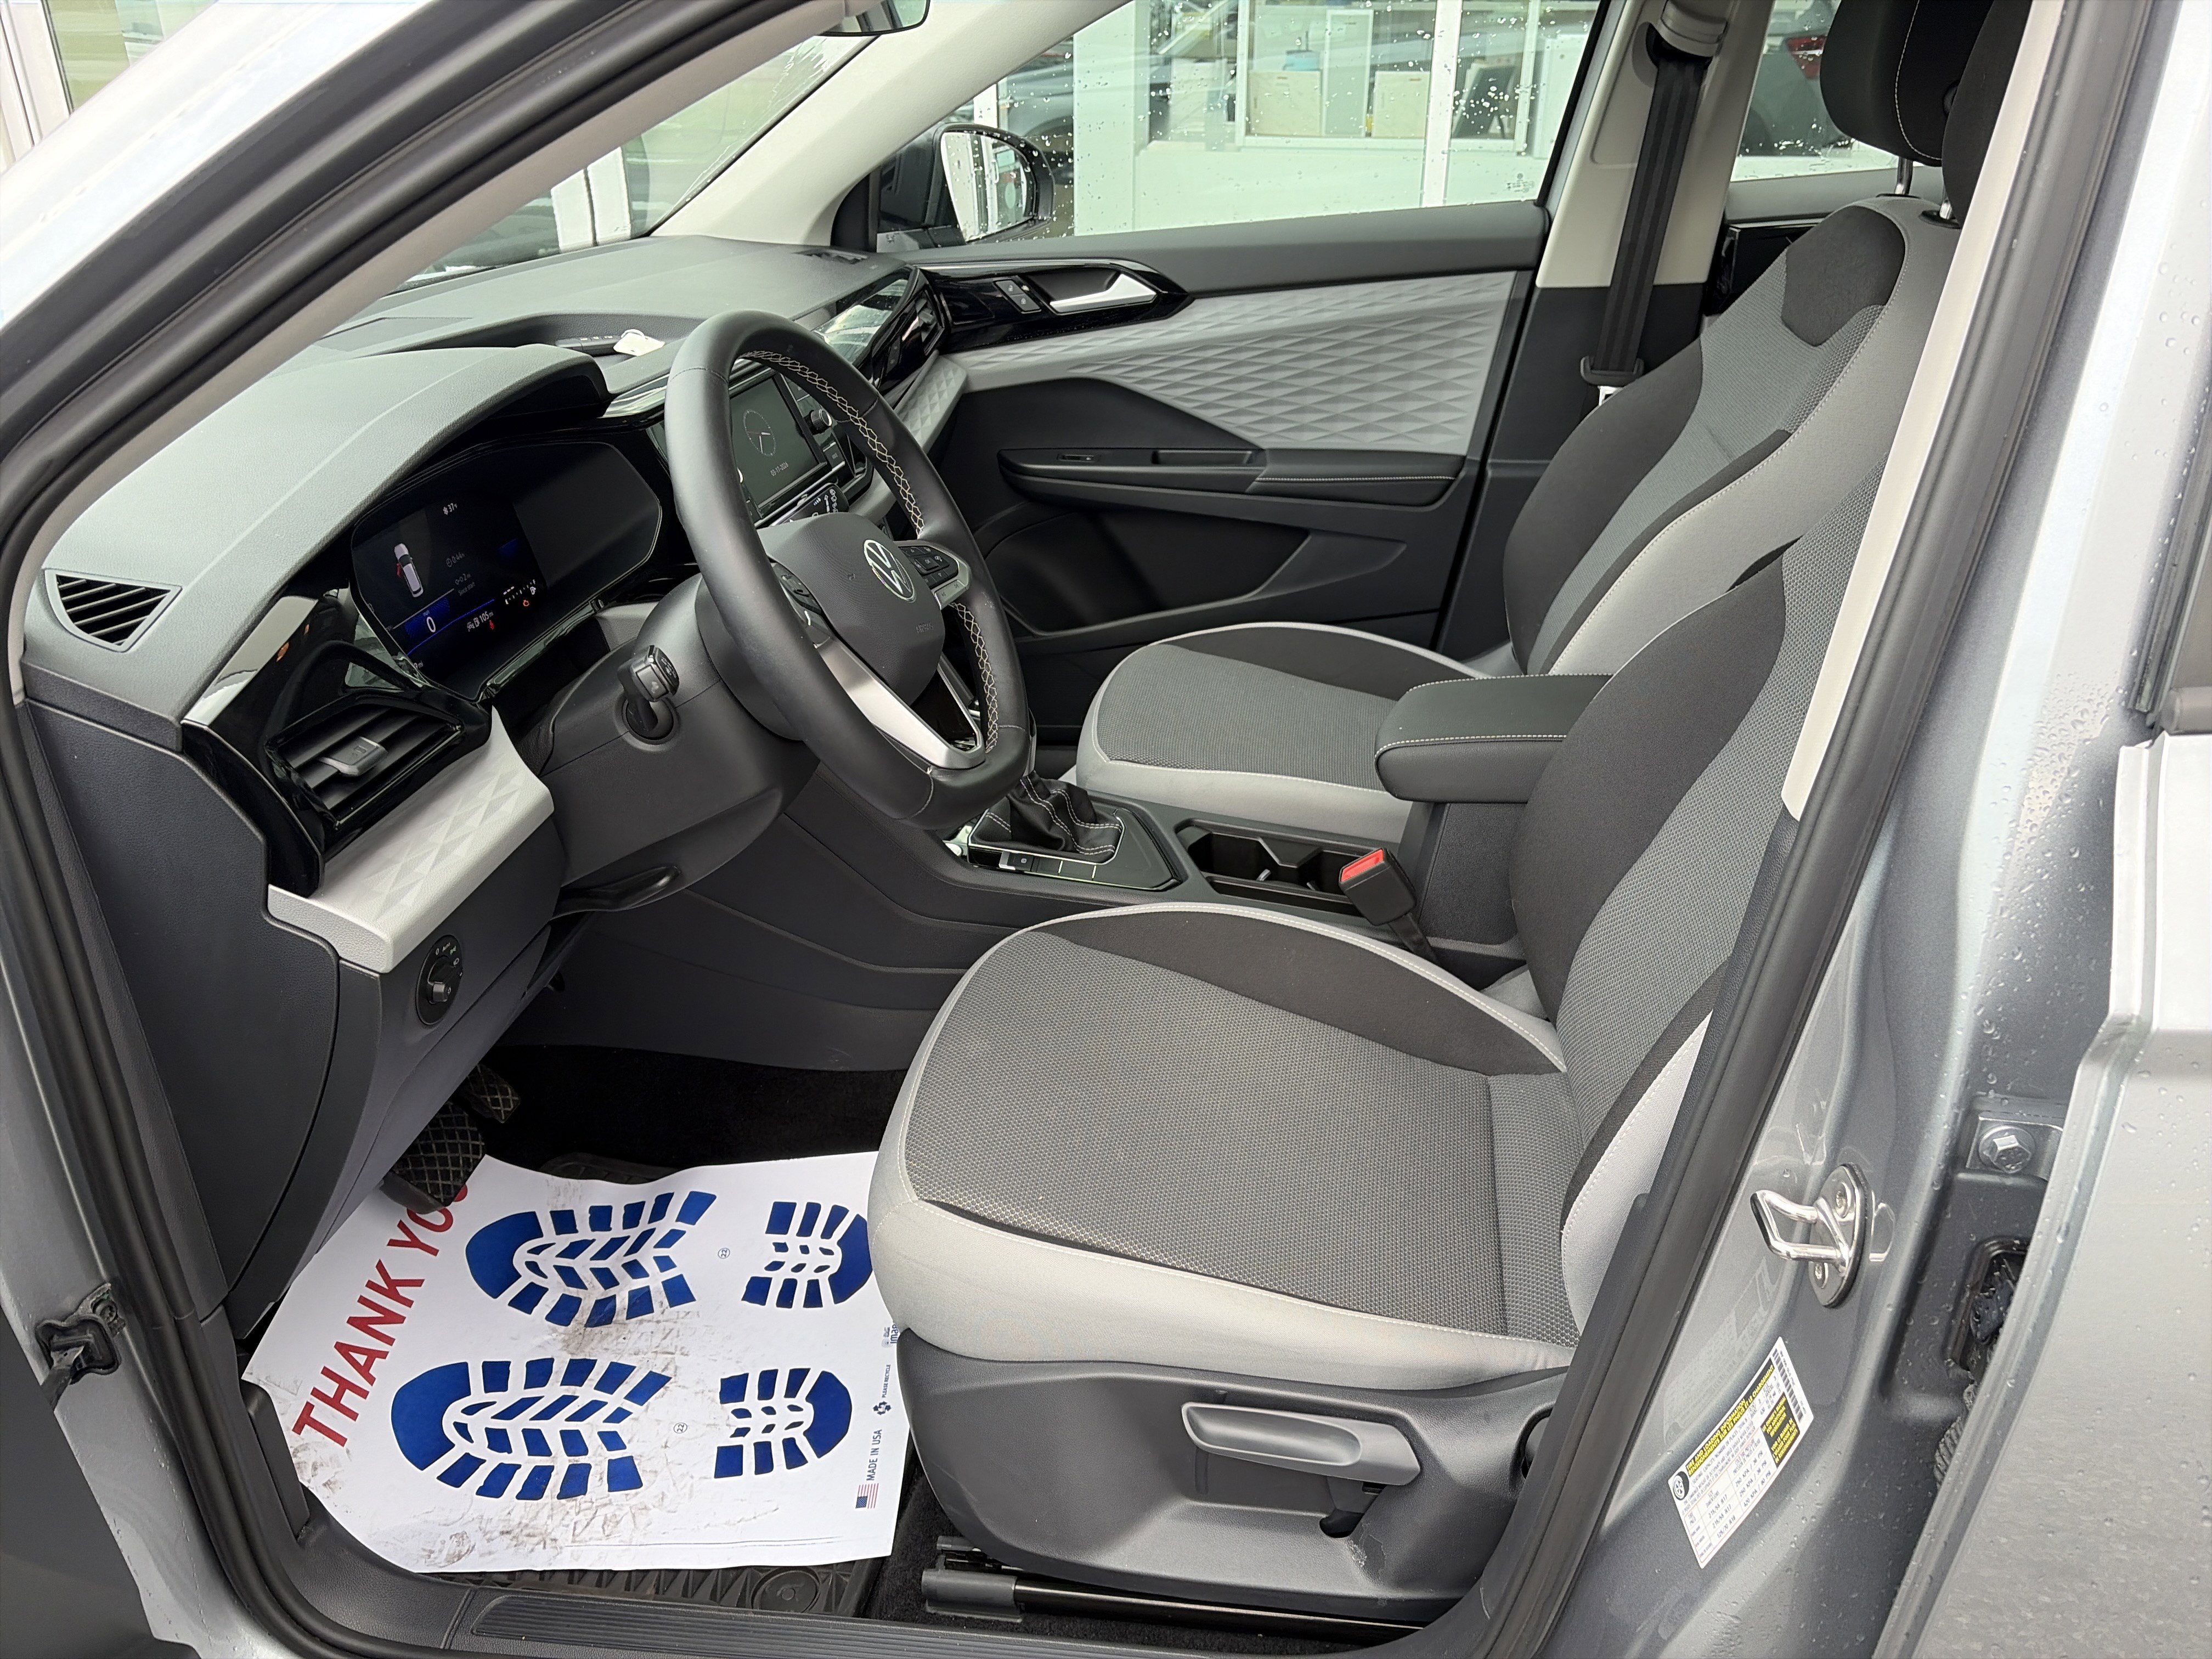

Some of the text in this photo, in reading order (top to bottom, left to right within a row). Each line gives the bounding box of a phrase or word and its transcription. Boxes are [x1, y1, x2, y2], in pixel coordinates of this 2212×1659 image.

[426, 616, 436, 633] 0
[479, 611, 489, 623] 105
[291, 1184, 468, 1447] THANK YO
[1752, 1364, 1774, 1398] CHARGEMENT
[1694, 1449, 1703, 1462] AND
[1703, 1429, 1720, 1452] LOADING
[1720, 1398, 1745, 1432] INFORMATION
[866, 1458, 878, 1481] MADE
[872, 1429, 883, 1445] USA
